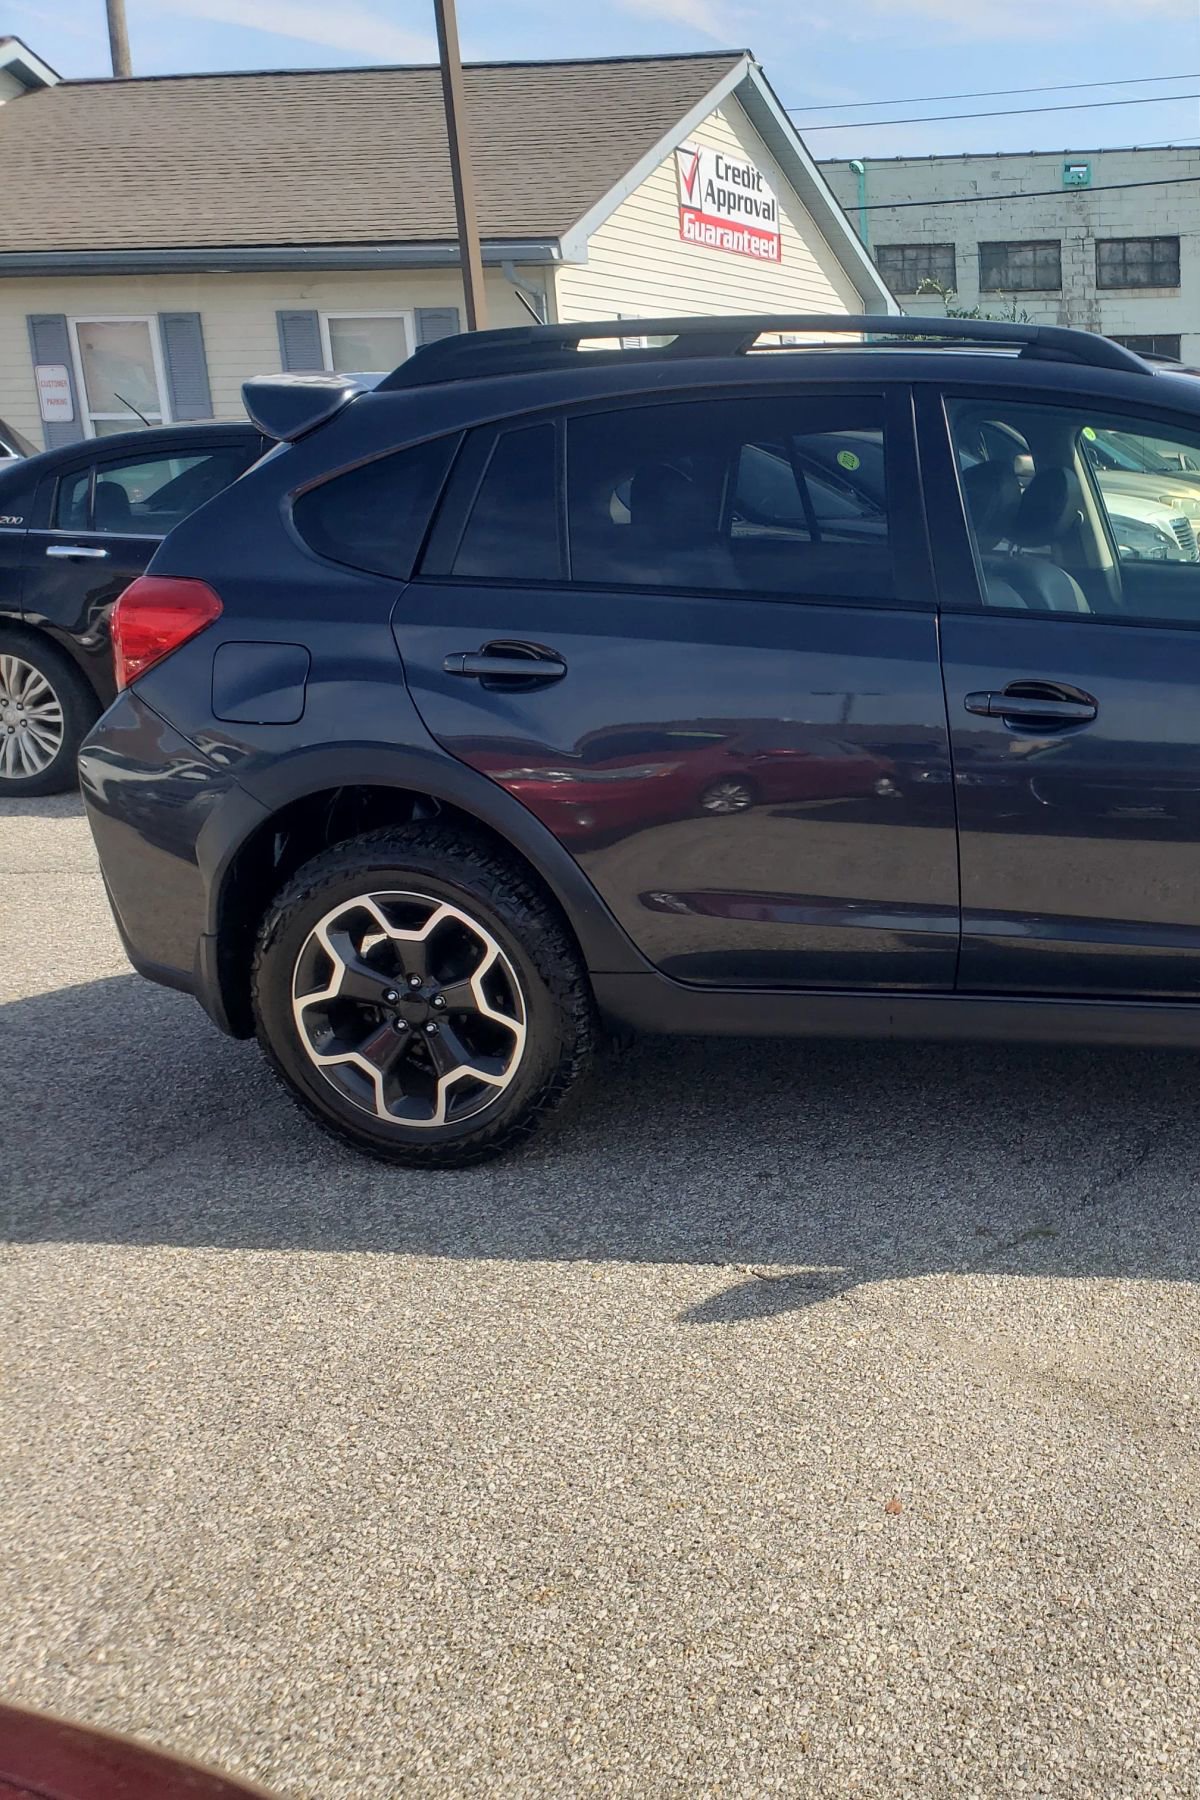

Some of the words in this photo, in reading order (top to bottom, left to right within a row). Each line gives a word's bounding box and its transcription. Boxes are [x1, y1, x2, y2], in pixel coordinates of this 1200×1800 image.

[715, 154, 763, 193] Credit
[704, 178, 776, 222] Approval
[683, 212, 778, 260] Guaranteed
[40, 379, 68, 388] CUSTOMER
[46, 398, 68, 406] PARKING
